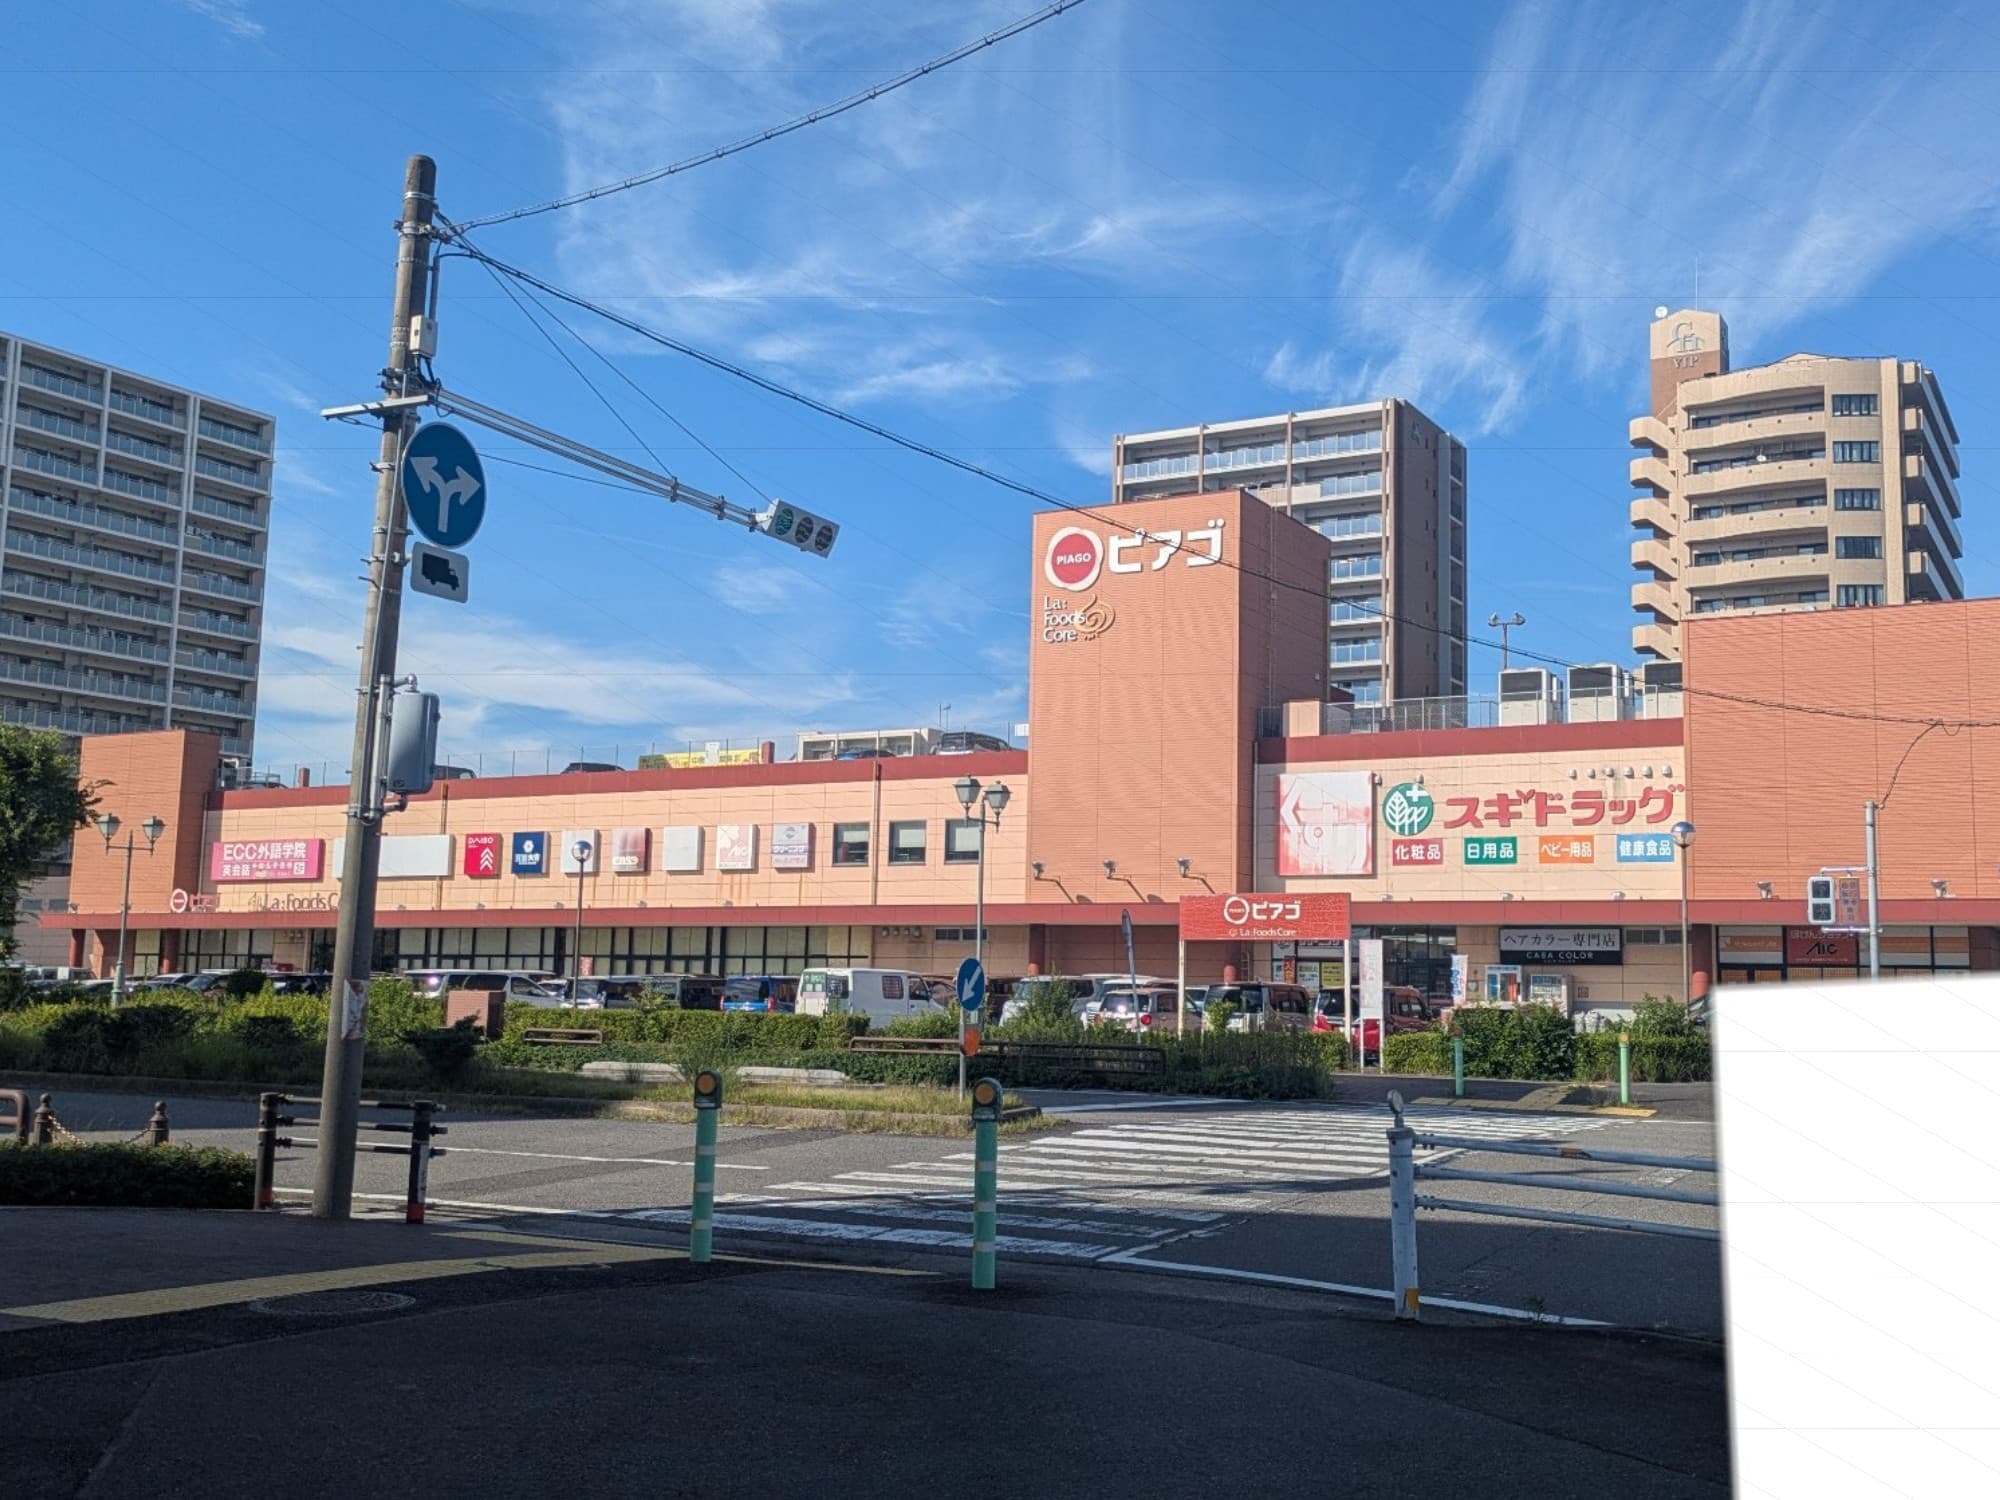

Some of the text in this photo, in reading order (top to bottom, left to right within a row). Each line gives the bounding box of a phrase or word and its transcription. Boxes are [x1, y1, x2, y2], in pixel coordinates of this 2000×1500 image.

[1673, 355, 1699, 369] VIP
[1109, 518, 1225, 574] ピアゴ
[1056, 553, 1092, 566] PIAGO
[1043, 610, 1087, 627] Foods
[1043, 627, 1078, 643] Core
[1443, 784, 1685, 829] スギドラッグ
[1395, 844, 1441, 862] 化粧品
[1467, 842, 1514, 860] 日用品
[1541, 840, 1593, 859] ベビー用品
[1618, 838, 1673, 858] 健康食品
[287, 892, 327, 911] Foods
[1252, 900, 1301, 920] ピアゴ
[1503, 932, 1616, 948] ヘアカラー専門店
[1558, 951, 1594, 960] COLOR
